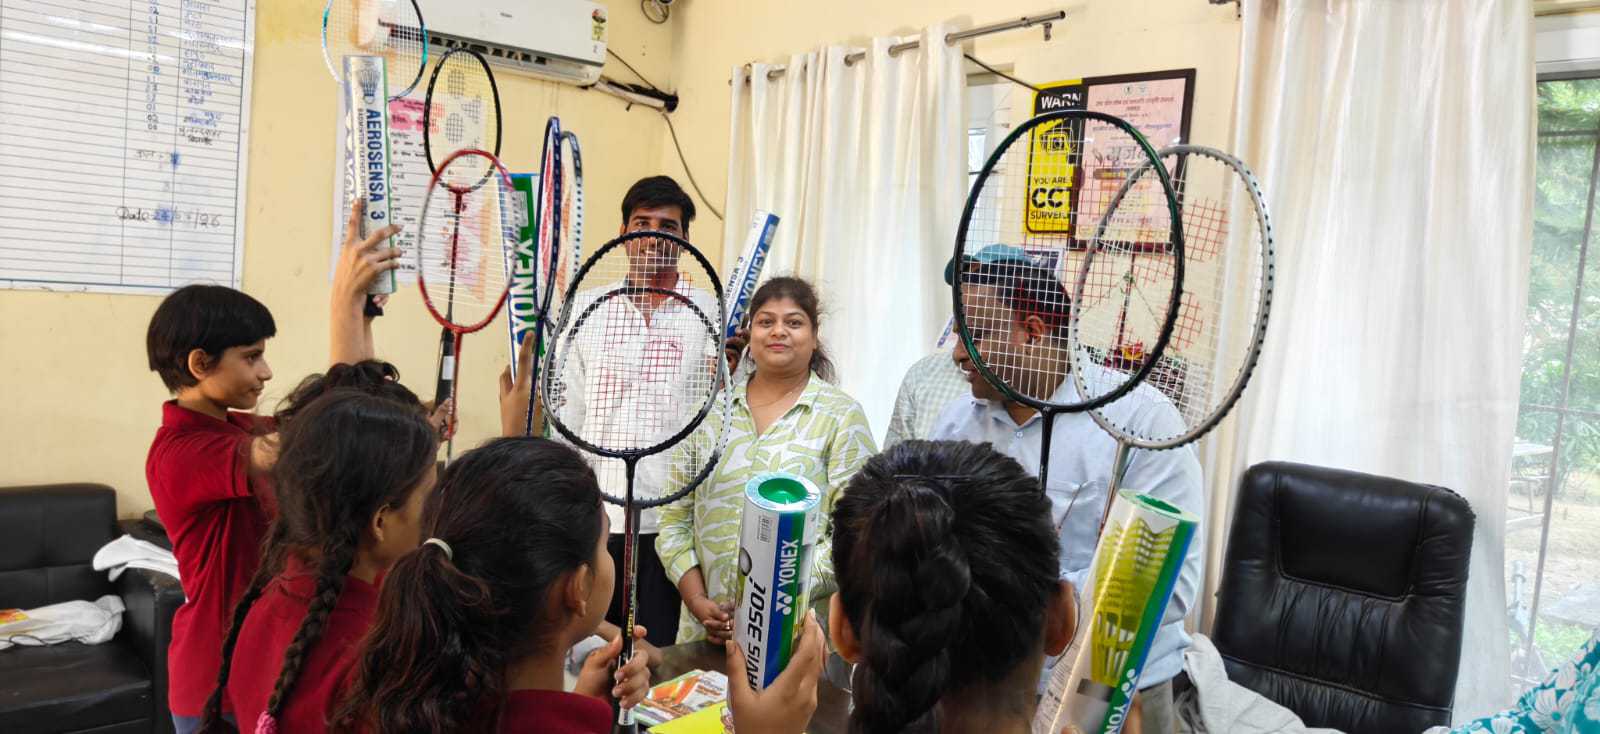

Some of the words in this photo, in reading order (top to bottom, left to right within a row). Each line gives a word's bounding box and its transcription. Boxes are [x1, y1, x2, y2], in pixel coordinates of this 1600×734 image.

[366, 108, 385, 202] AEROSENSA
[370, 210, 385, 220] 3
[505, 238, 537, 335] YONEX
[777, 539, 799, 587] YONEX
[747, 576, 767, 642] 350i
[1104, 704, 1129, 734] YON
